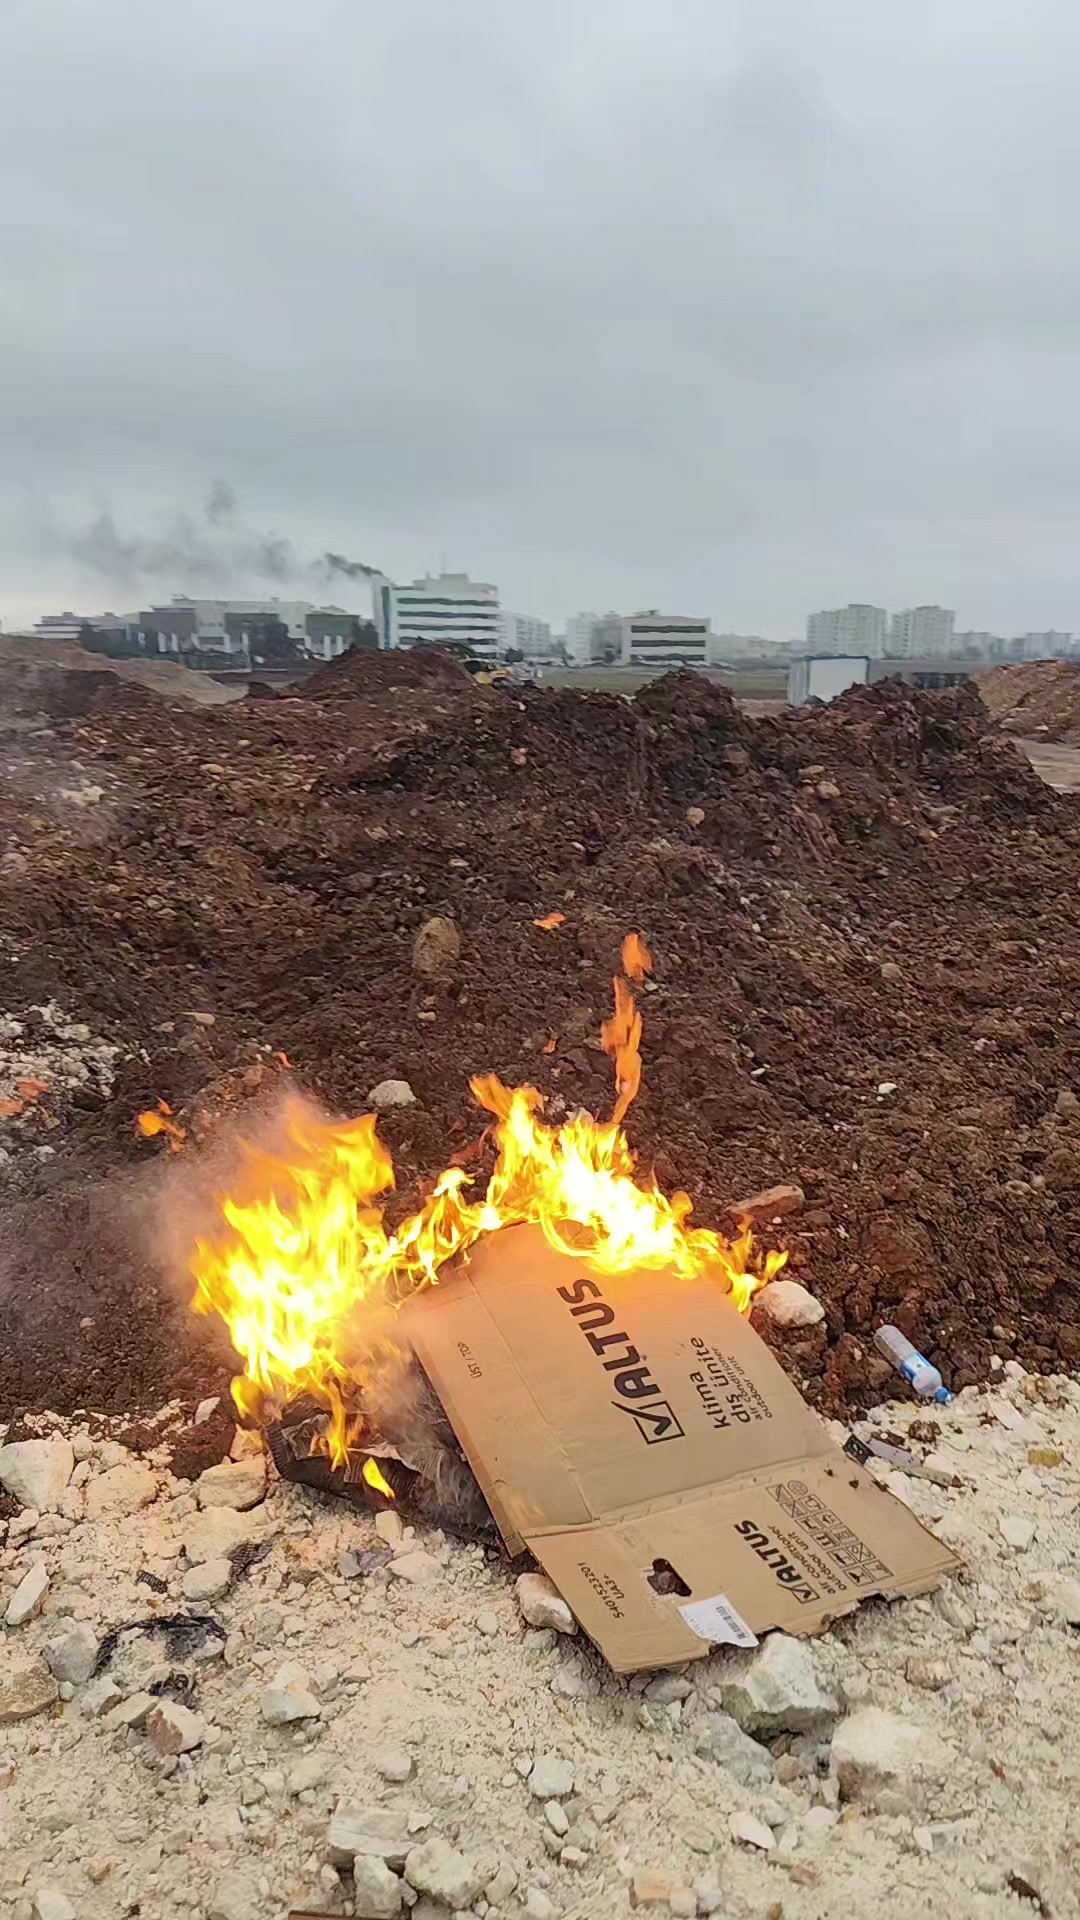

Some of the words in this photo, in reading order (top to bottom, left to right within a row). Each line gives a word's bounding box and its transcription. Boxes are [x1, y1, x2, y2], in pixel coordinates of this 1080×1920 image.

[556, 1278, 661, 1398] ALTUS
[690, 1336, 729, 1387] ünite
[711, 1346, 751, 1401] conditioner
[727, 1355, 745, 1375] unit
[688, 1371, 732, 1428] klima
[742, 1378, 773, 1418] outdoor
[733, 1519, 801, 1581] ALTUS
[766, 1523, 820, 1577] conditioner
[786, 1531, 808, 1550] unit
[807, 1552, 847, 1591] outdoor
[818, 1580, 836, 1594] air
